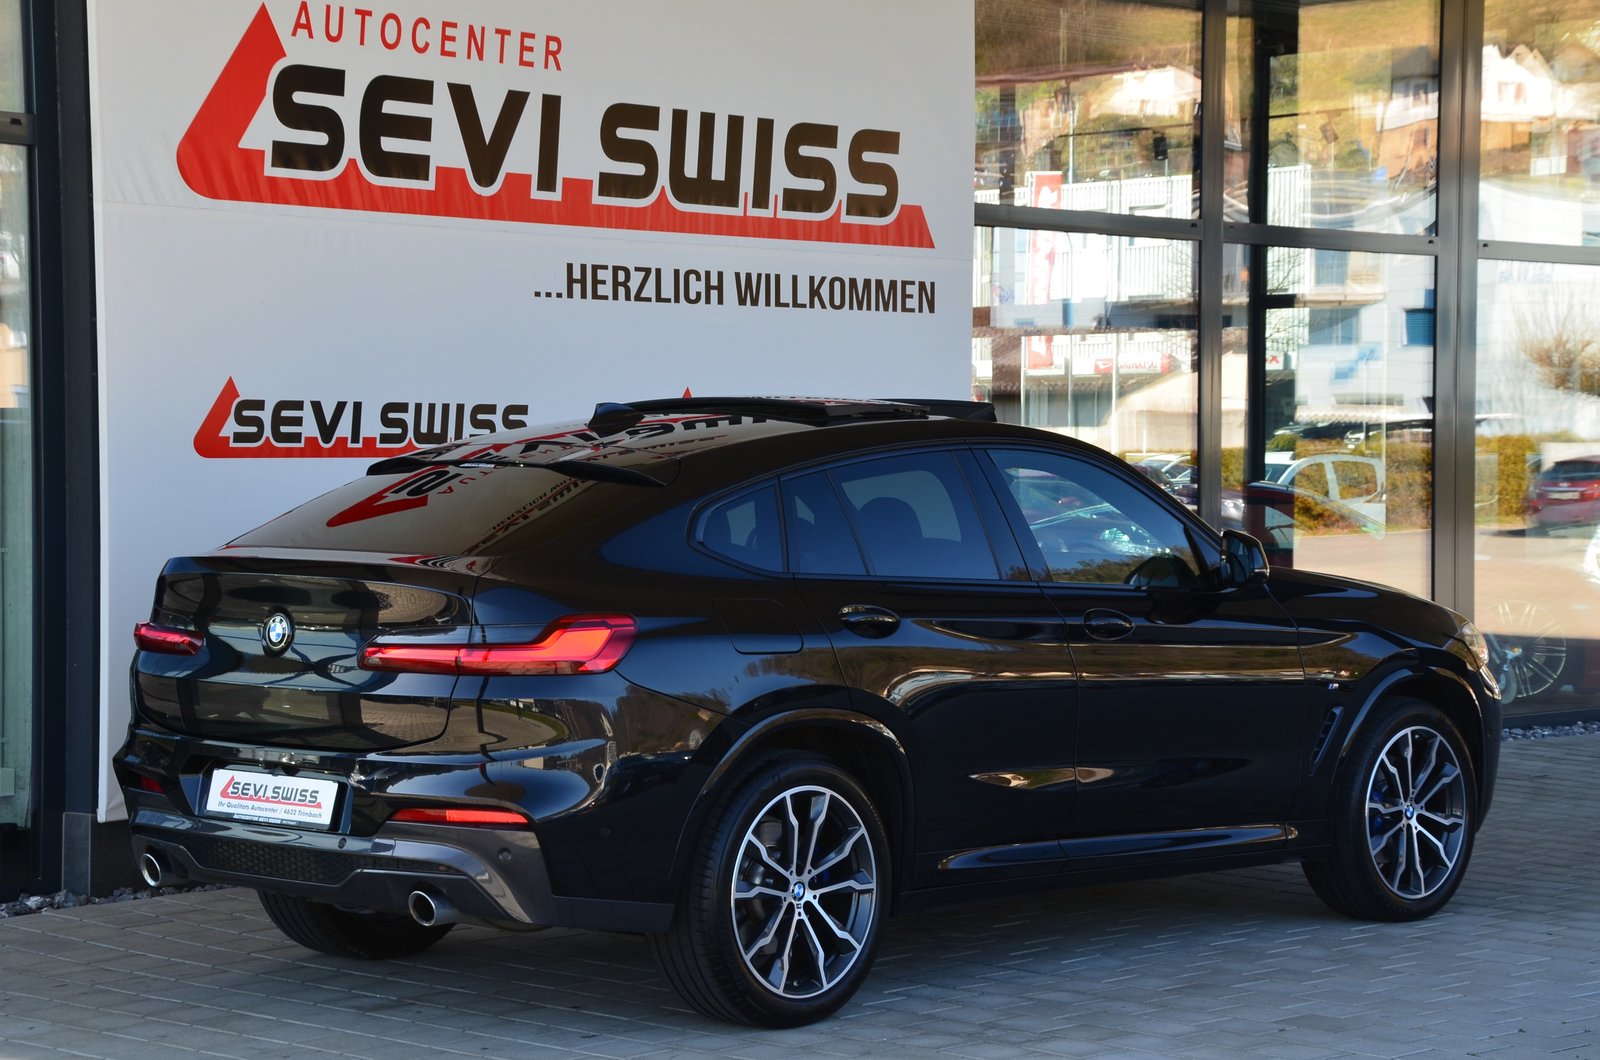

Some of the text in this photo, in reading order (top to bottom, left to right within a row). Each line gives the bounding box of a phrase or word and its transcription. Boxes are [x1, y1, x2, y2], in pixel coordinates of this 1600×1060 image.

[289, 0, 563, 72] AUTOCENTER
[271, 63, 901, 219] SEVI SWISS
[734, 271, 936, 314] WILLKOMMEN
[232, 398, 530, 446] SEVI SWISS
[230, 781, 320, 804] SEVI SWISS
[250, 804, 279, 813] Autocenter
